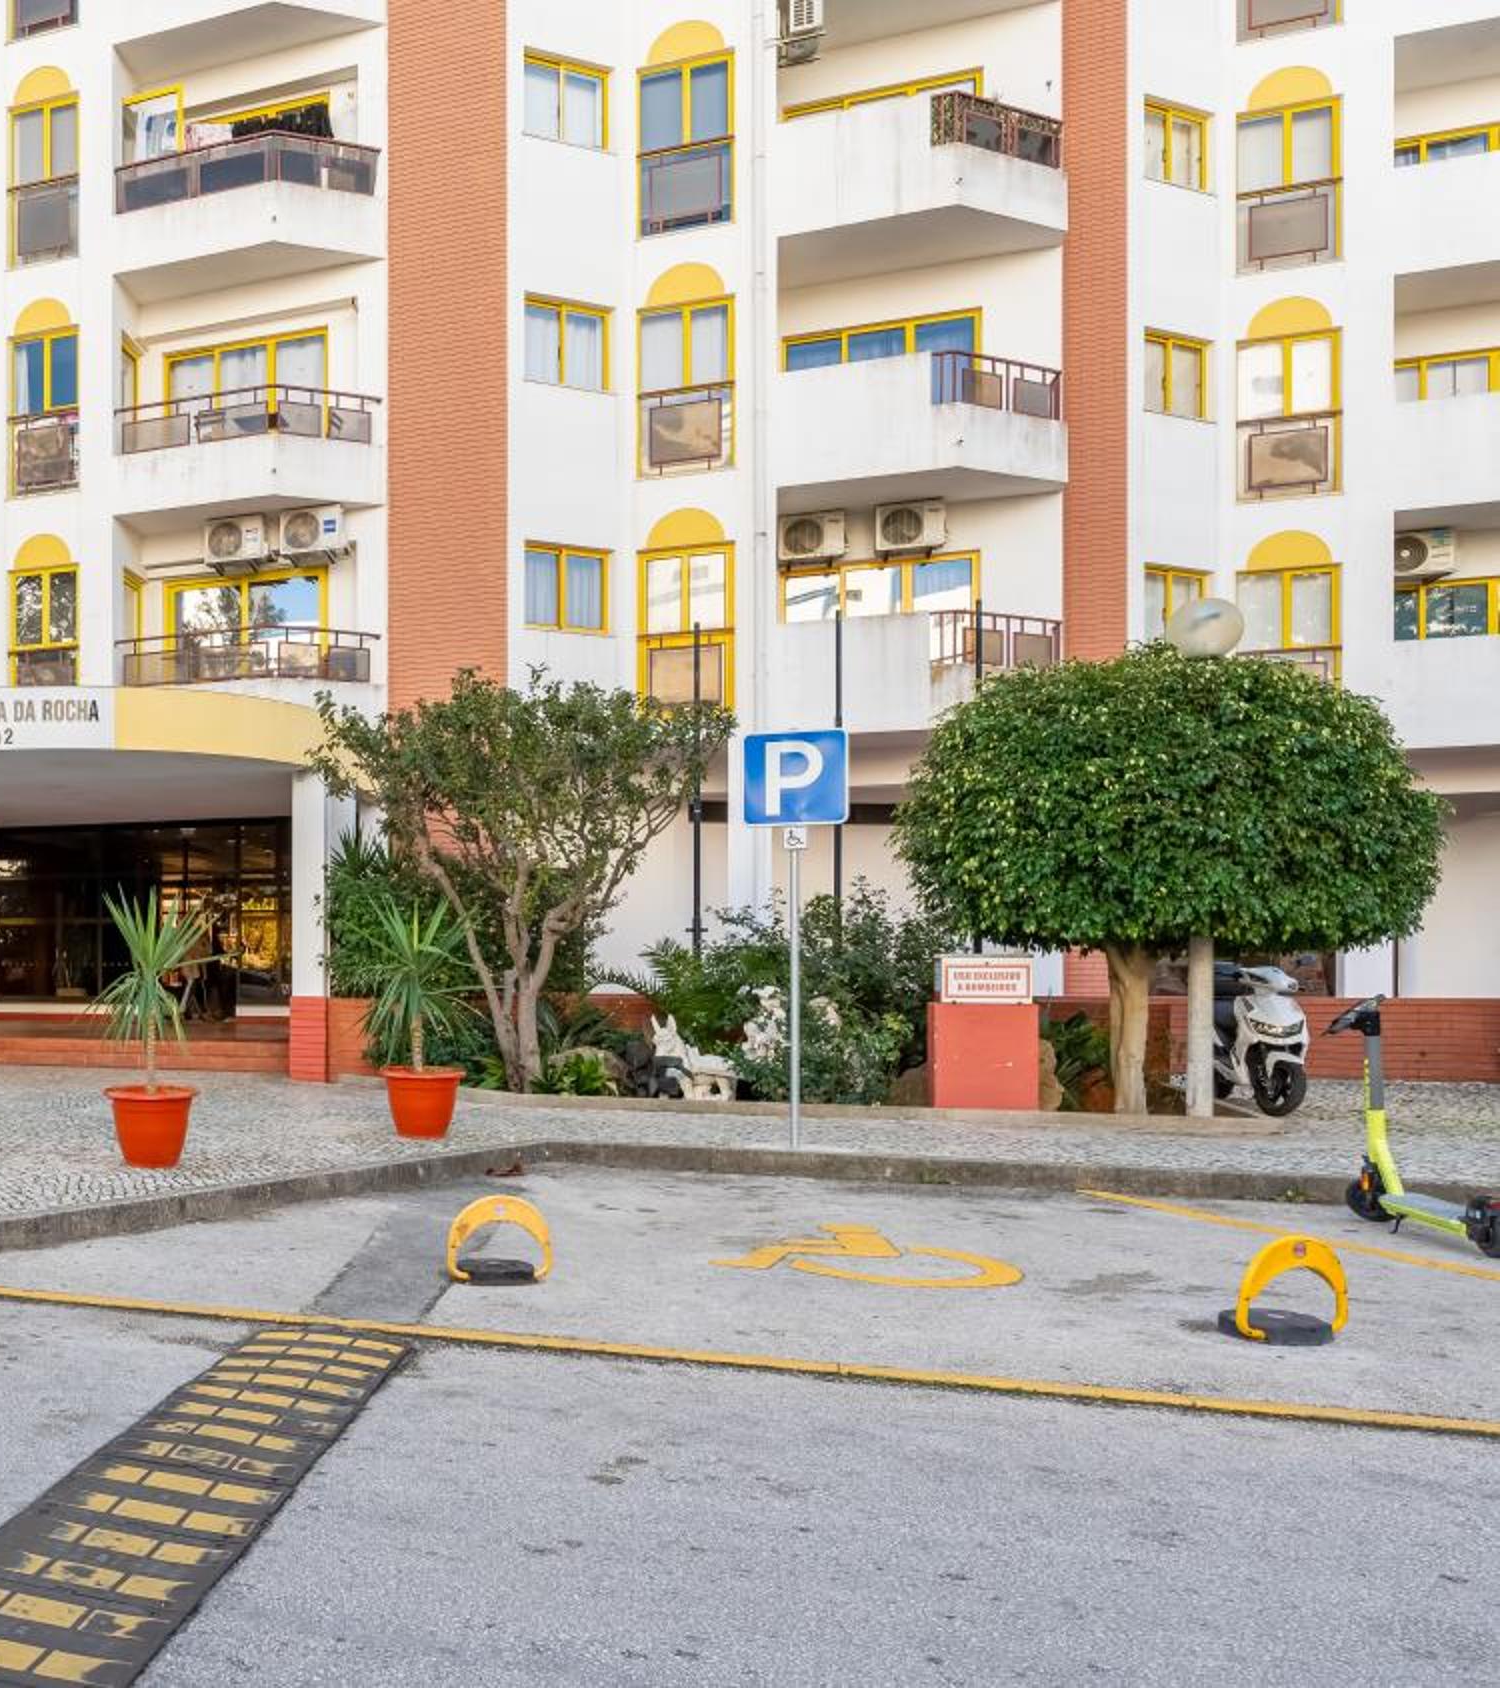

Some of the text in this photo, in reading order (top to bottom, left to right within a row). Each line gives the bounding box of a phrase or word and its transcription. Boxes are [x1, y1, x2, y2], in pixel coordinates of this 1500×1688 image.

[14, 700, 36, 722] DA
[43, 699, 99, 722] ROCHA
[765, 740, 823, 816] P
